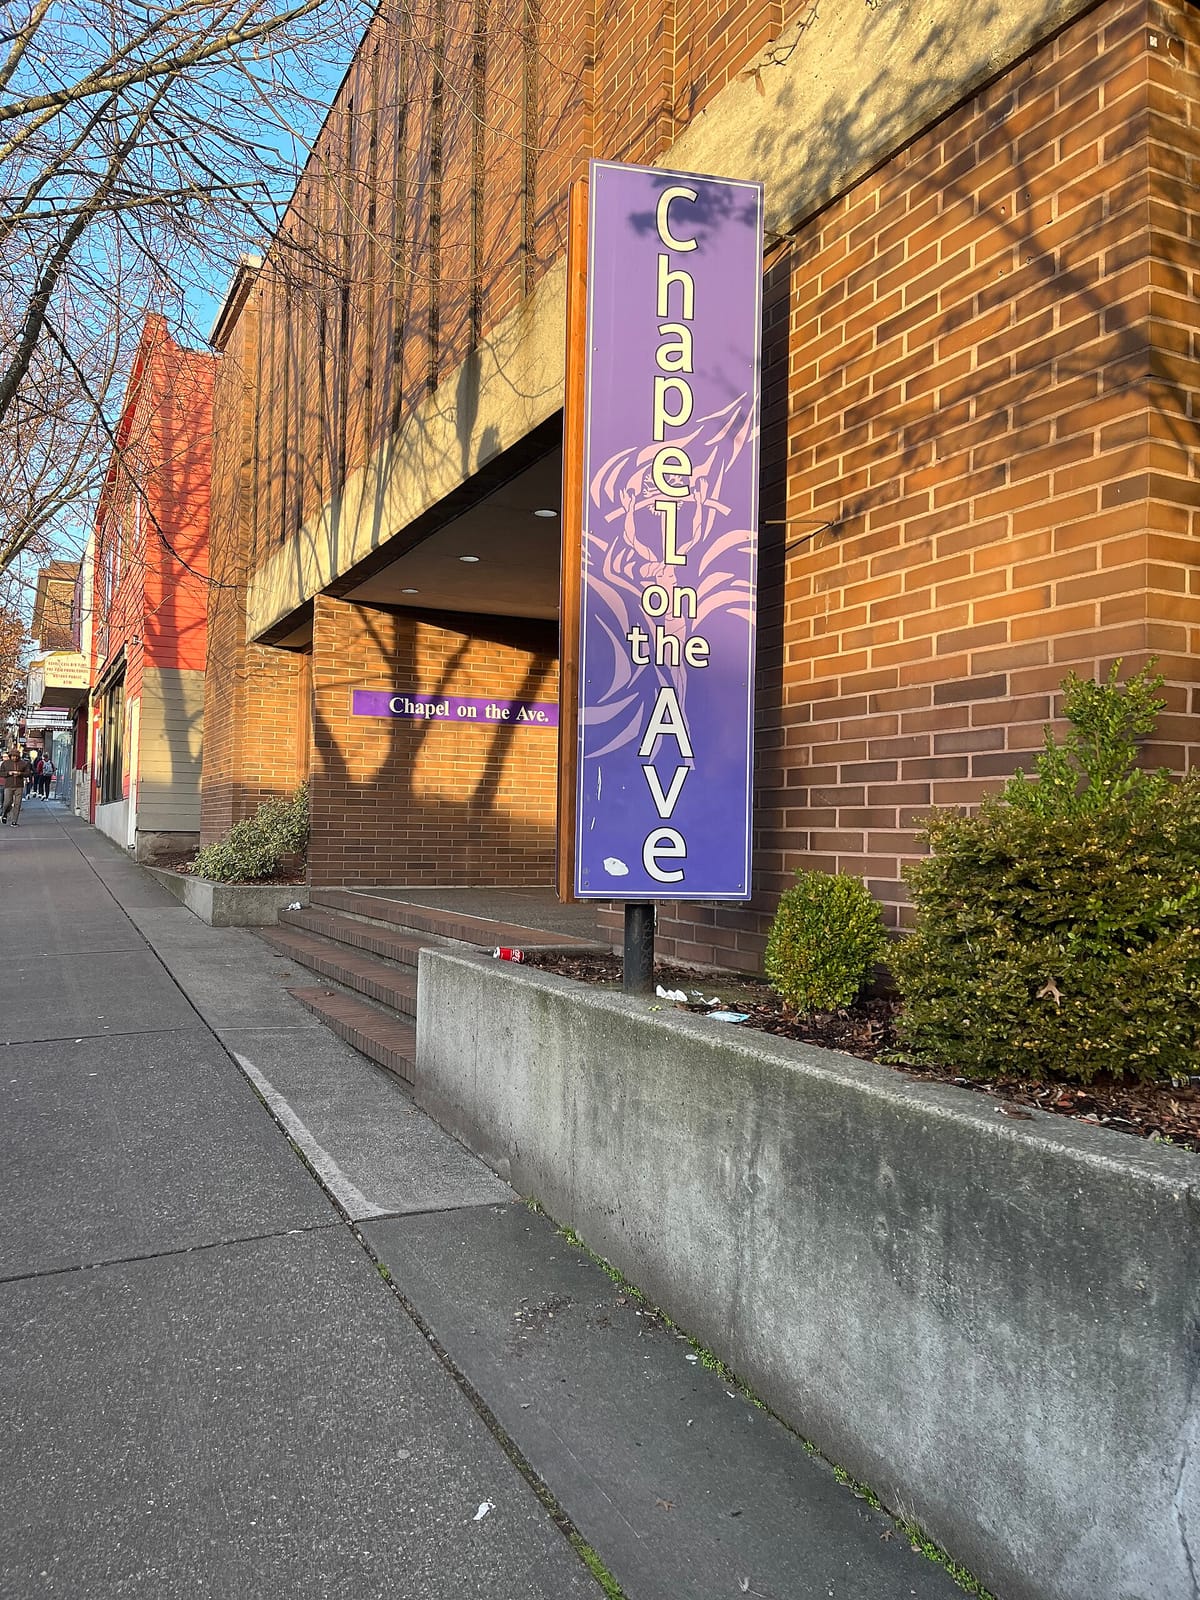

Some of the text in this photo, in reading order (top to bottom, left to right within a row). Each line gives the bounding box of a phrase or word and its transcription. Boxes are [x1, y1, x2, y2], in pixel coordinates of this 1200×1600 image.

[651, 186, 699, 566] Chapel
[641, 583, 698, 619] on
[626, 625, 711, 668] the
[389, 697, 549, 723] Chapel on the Ave.
[637, 686, 695, 884] Ave
